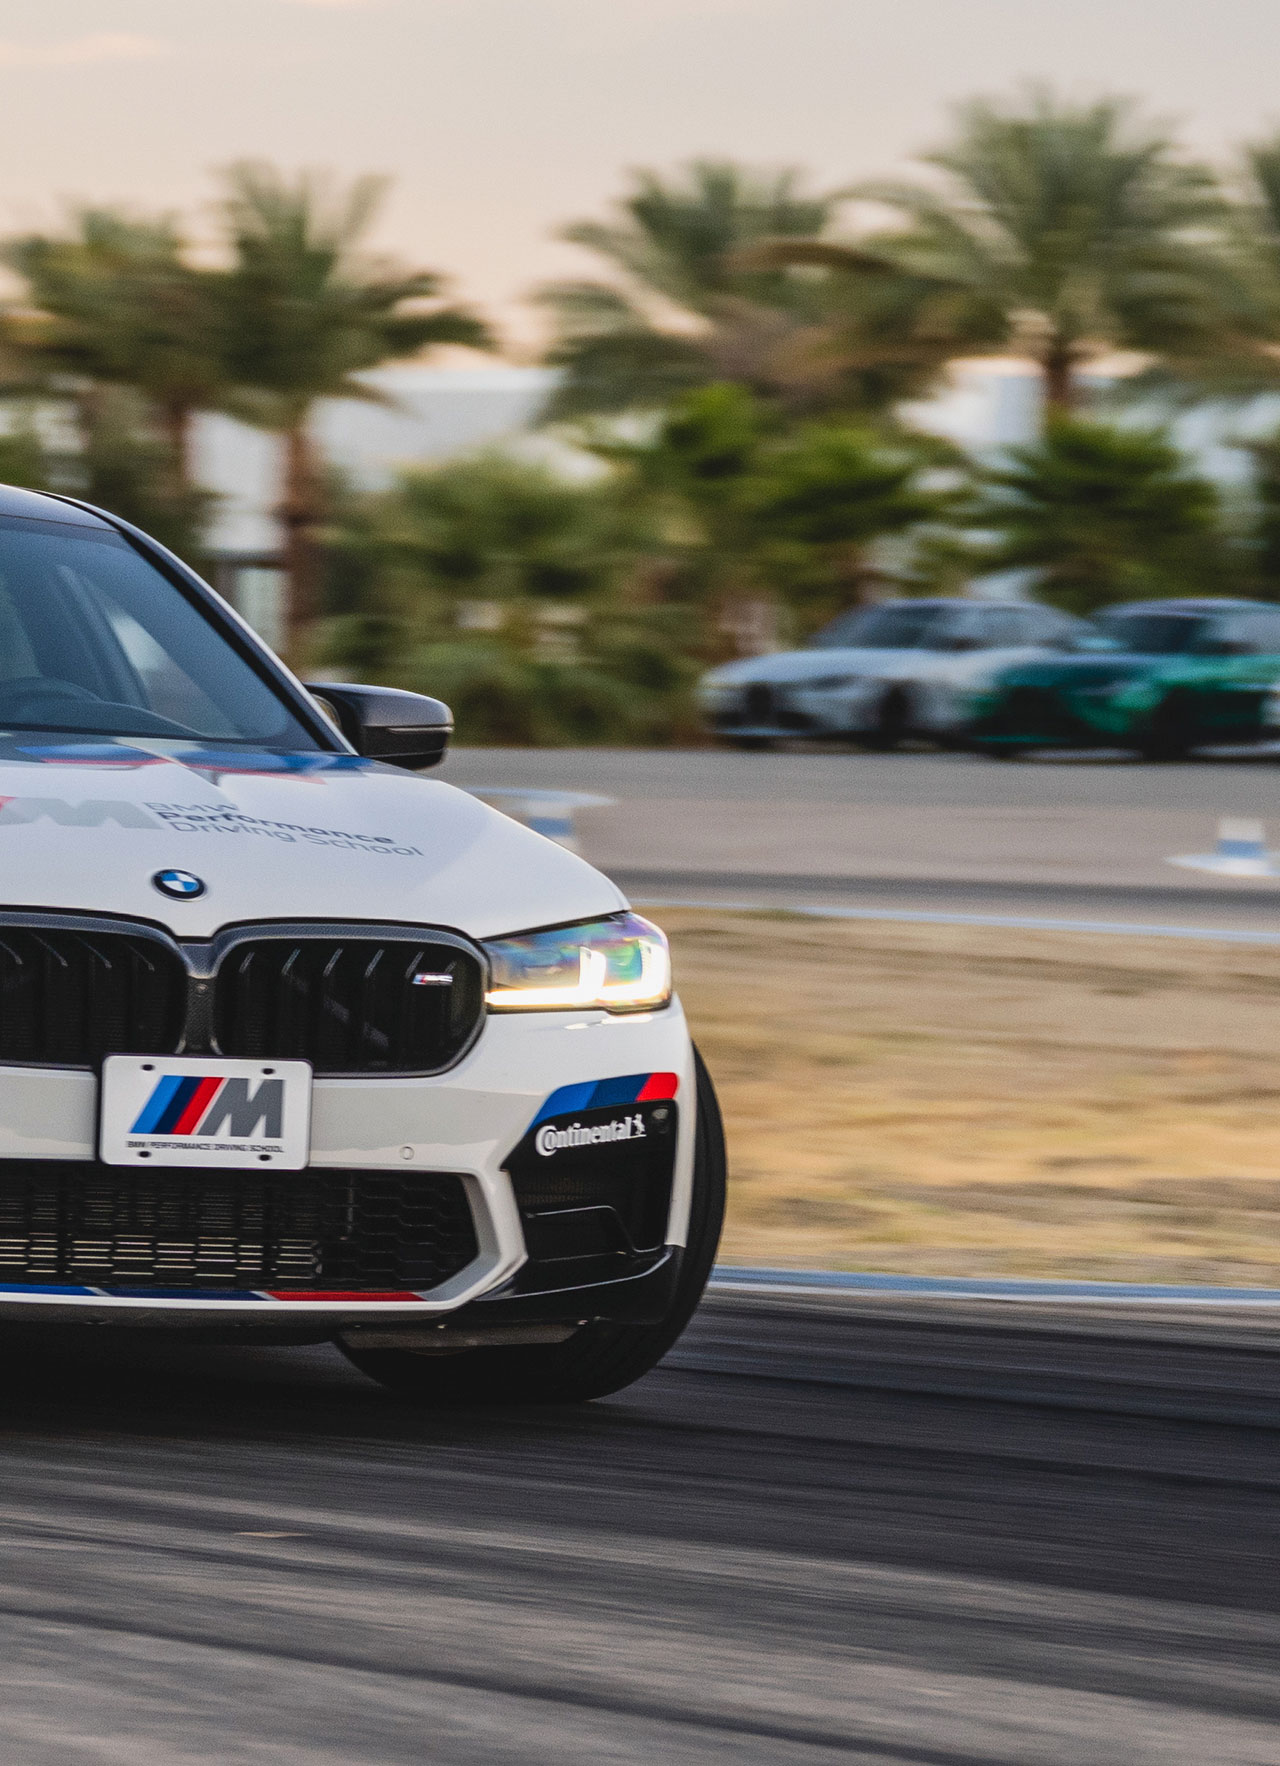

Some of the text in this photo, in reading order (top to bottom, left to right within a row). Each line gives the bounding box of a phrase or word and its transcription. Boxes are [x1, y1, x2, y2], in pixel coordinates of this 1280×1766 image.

[143, 802, 239, 812] BMW
[156, 811, 395, 844] Performance
[168, 821, 425, 857] Driving School
[197, 1077, 285, 1138] M
[535, 1116, 633, 1157] Continental
